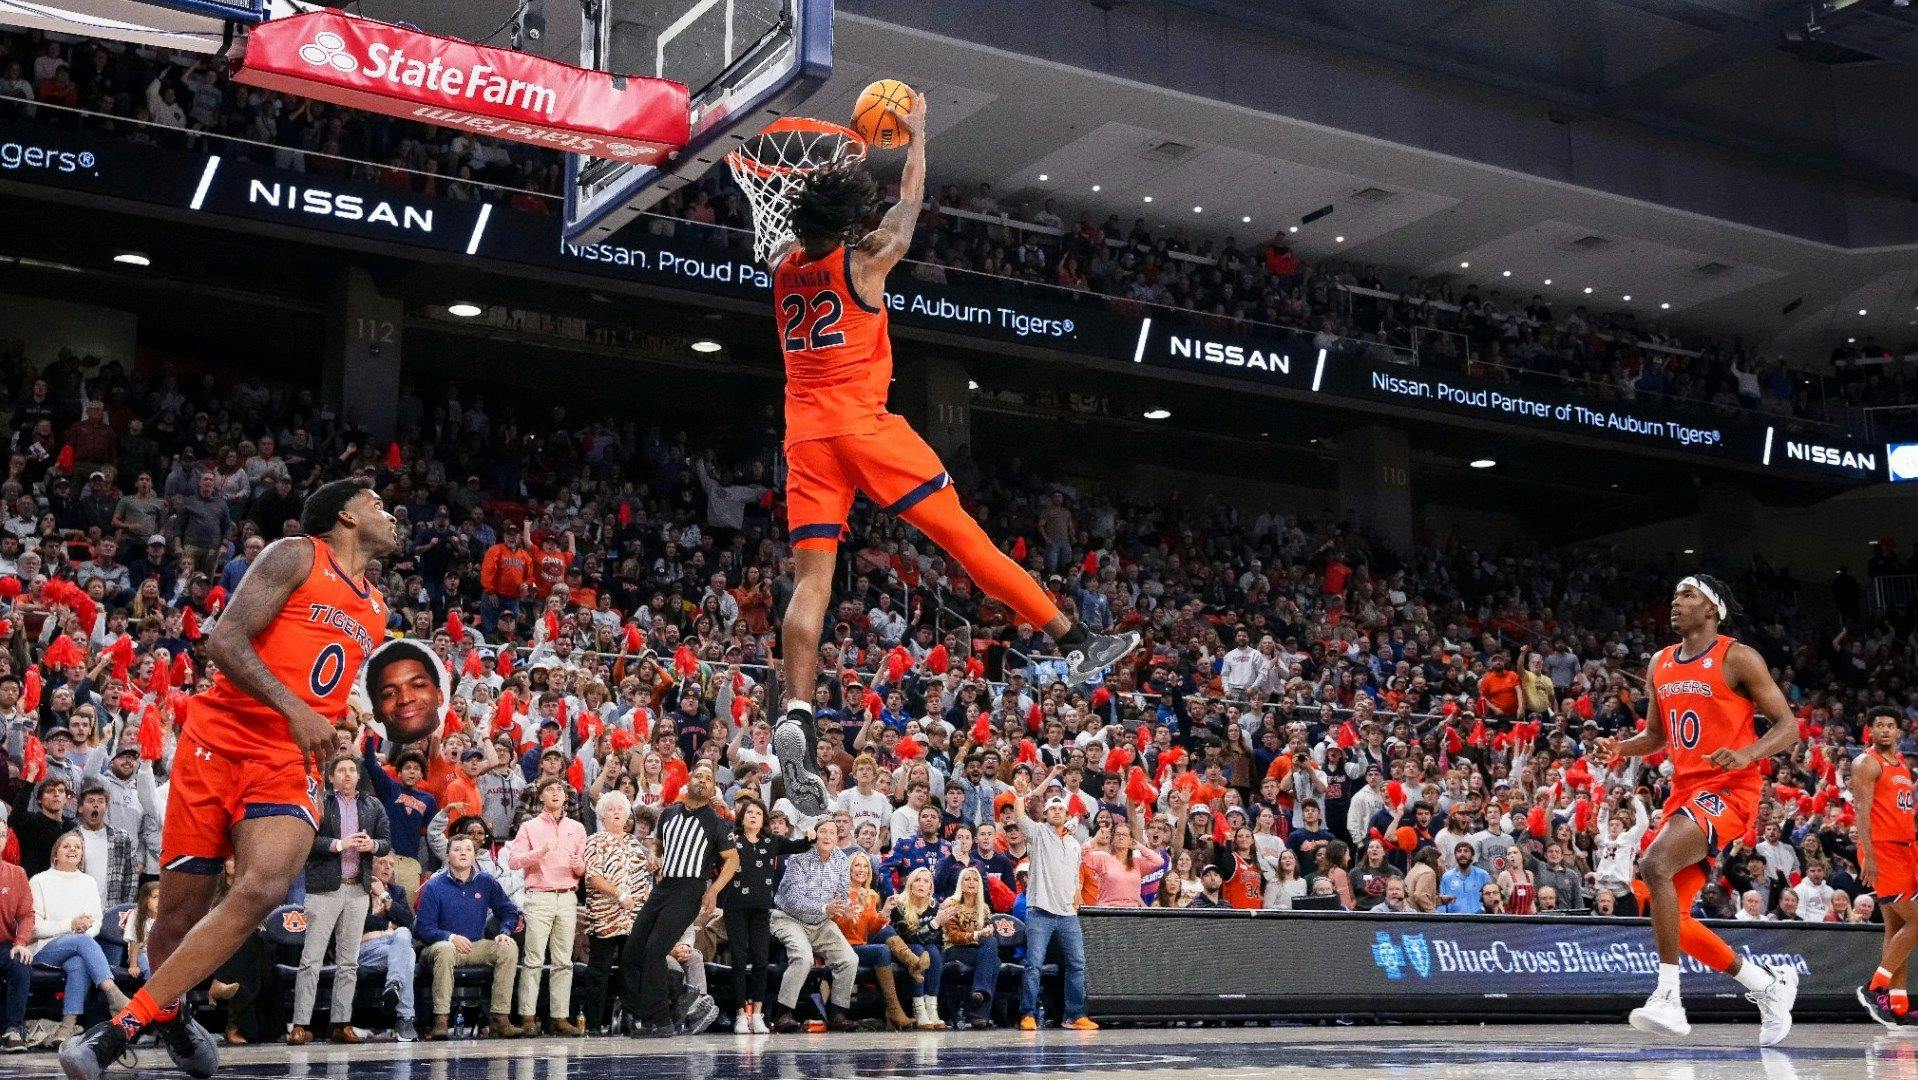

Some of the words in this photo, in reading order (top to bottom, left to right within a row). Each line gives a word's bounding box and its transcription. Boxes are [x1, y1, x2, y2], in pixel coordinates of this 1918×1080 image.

[1, 142, 99, 177] gers®.
[249, 178, 434, 233] NISSAN
[658, 250, 732, 282] Proud
[781, 289, 847, 353] 22
[882, 291, 905, 311] he
[911, 294, 992, 325] Auburn
[356, 318, 395, 344] 112
[1170, 336, 1290, 374] NISSAN
[1371, 371, 1434, 398] Nissan.
[1437, 382, 1487, 408] Proud
[1490, 392, 1551, 418] Partner
[1555, 404, 1572, 421] of
[1574, 406, 1605, 428] The
[1607, 413, 1664, 437] Auburn
[1786, 441, 1876, 471] NISSAN
[308, 602, 374, 658] TIGERS
[309, 642, 346, 698] 0
[1658, 680, 1713, 699] TIGERS
[1669, 708, 1701, 750] 10
[854, 811, 881, 820] AUBURN
[1896, 789, 1914, 813] 44
[1432, 940, 1561, 973] BlueCross
